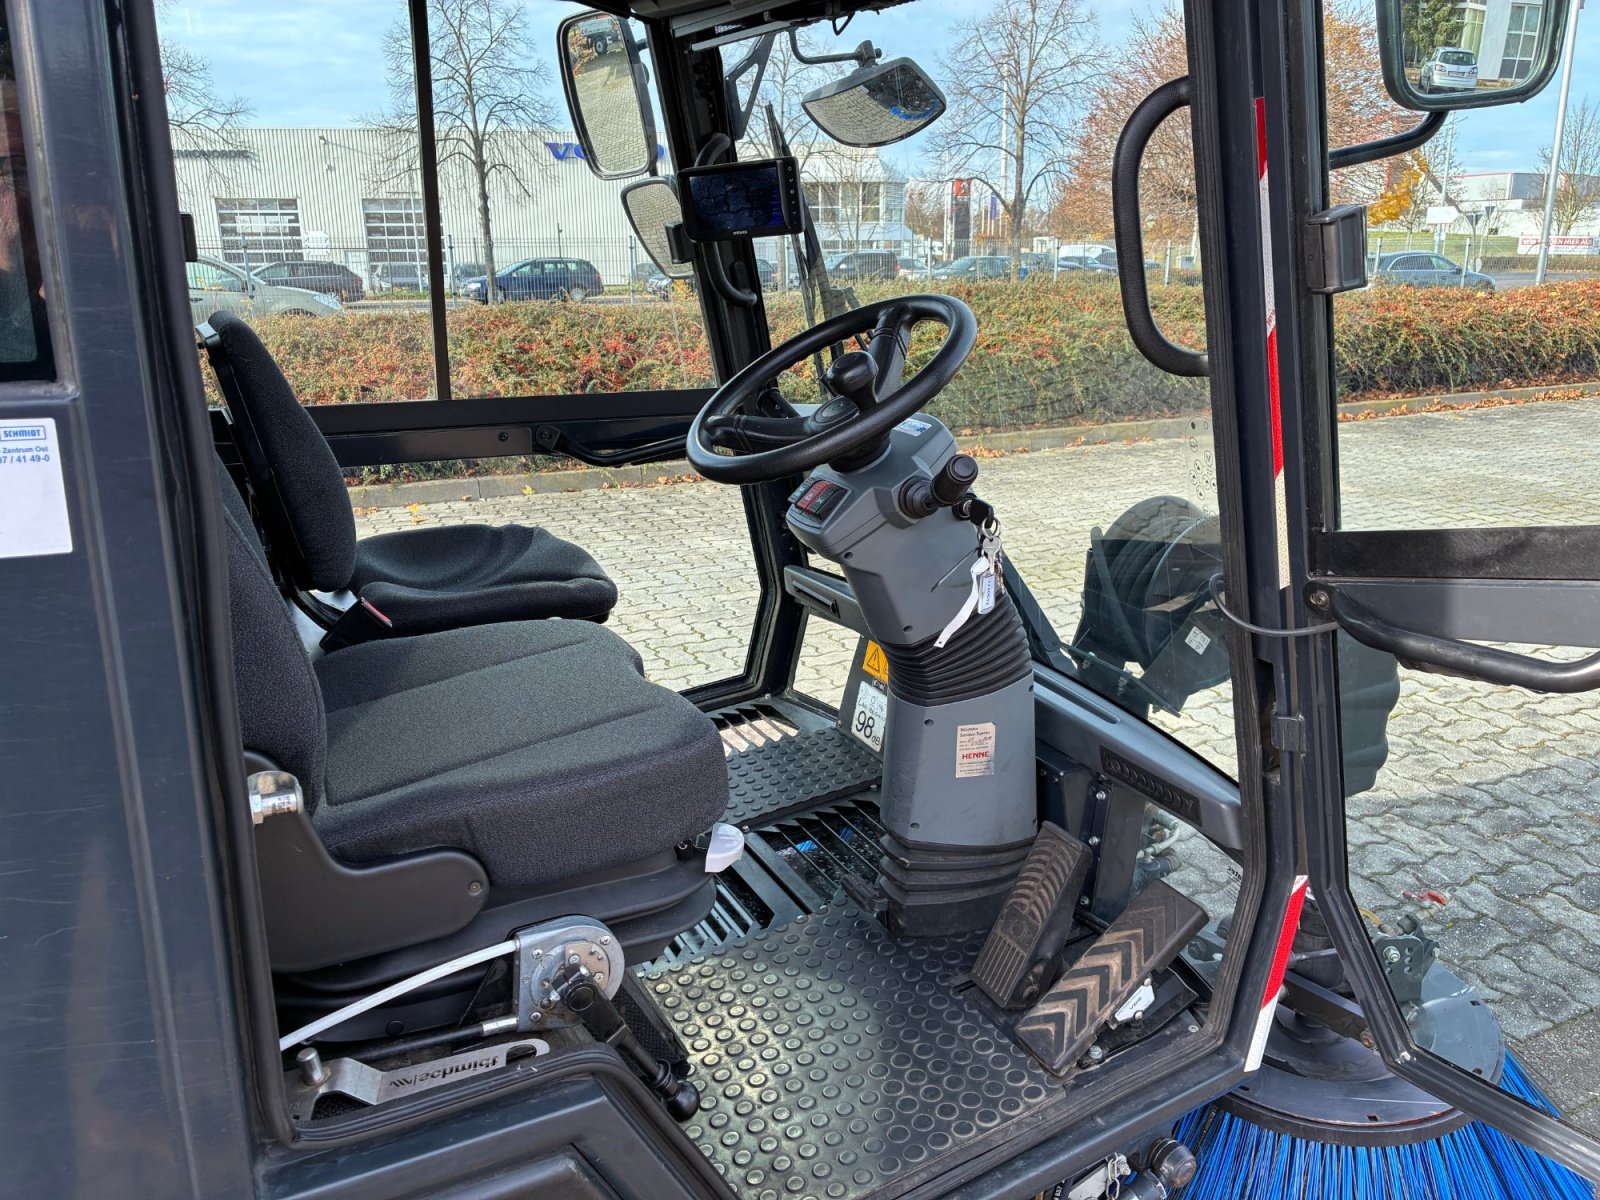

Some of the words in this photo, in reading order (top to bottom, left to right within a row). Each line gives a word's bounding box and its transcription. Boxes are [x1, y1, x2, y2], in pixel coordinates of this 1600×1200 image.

[3, 429, 41, 438] SCHMIDT
[16, 455, 26, 463] 41
[855, 711, 875, 738] 98
[871, 735, 881, 746] dB
[962, 750, 989, 760] HENNE
